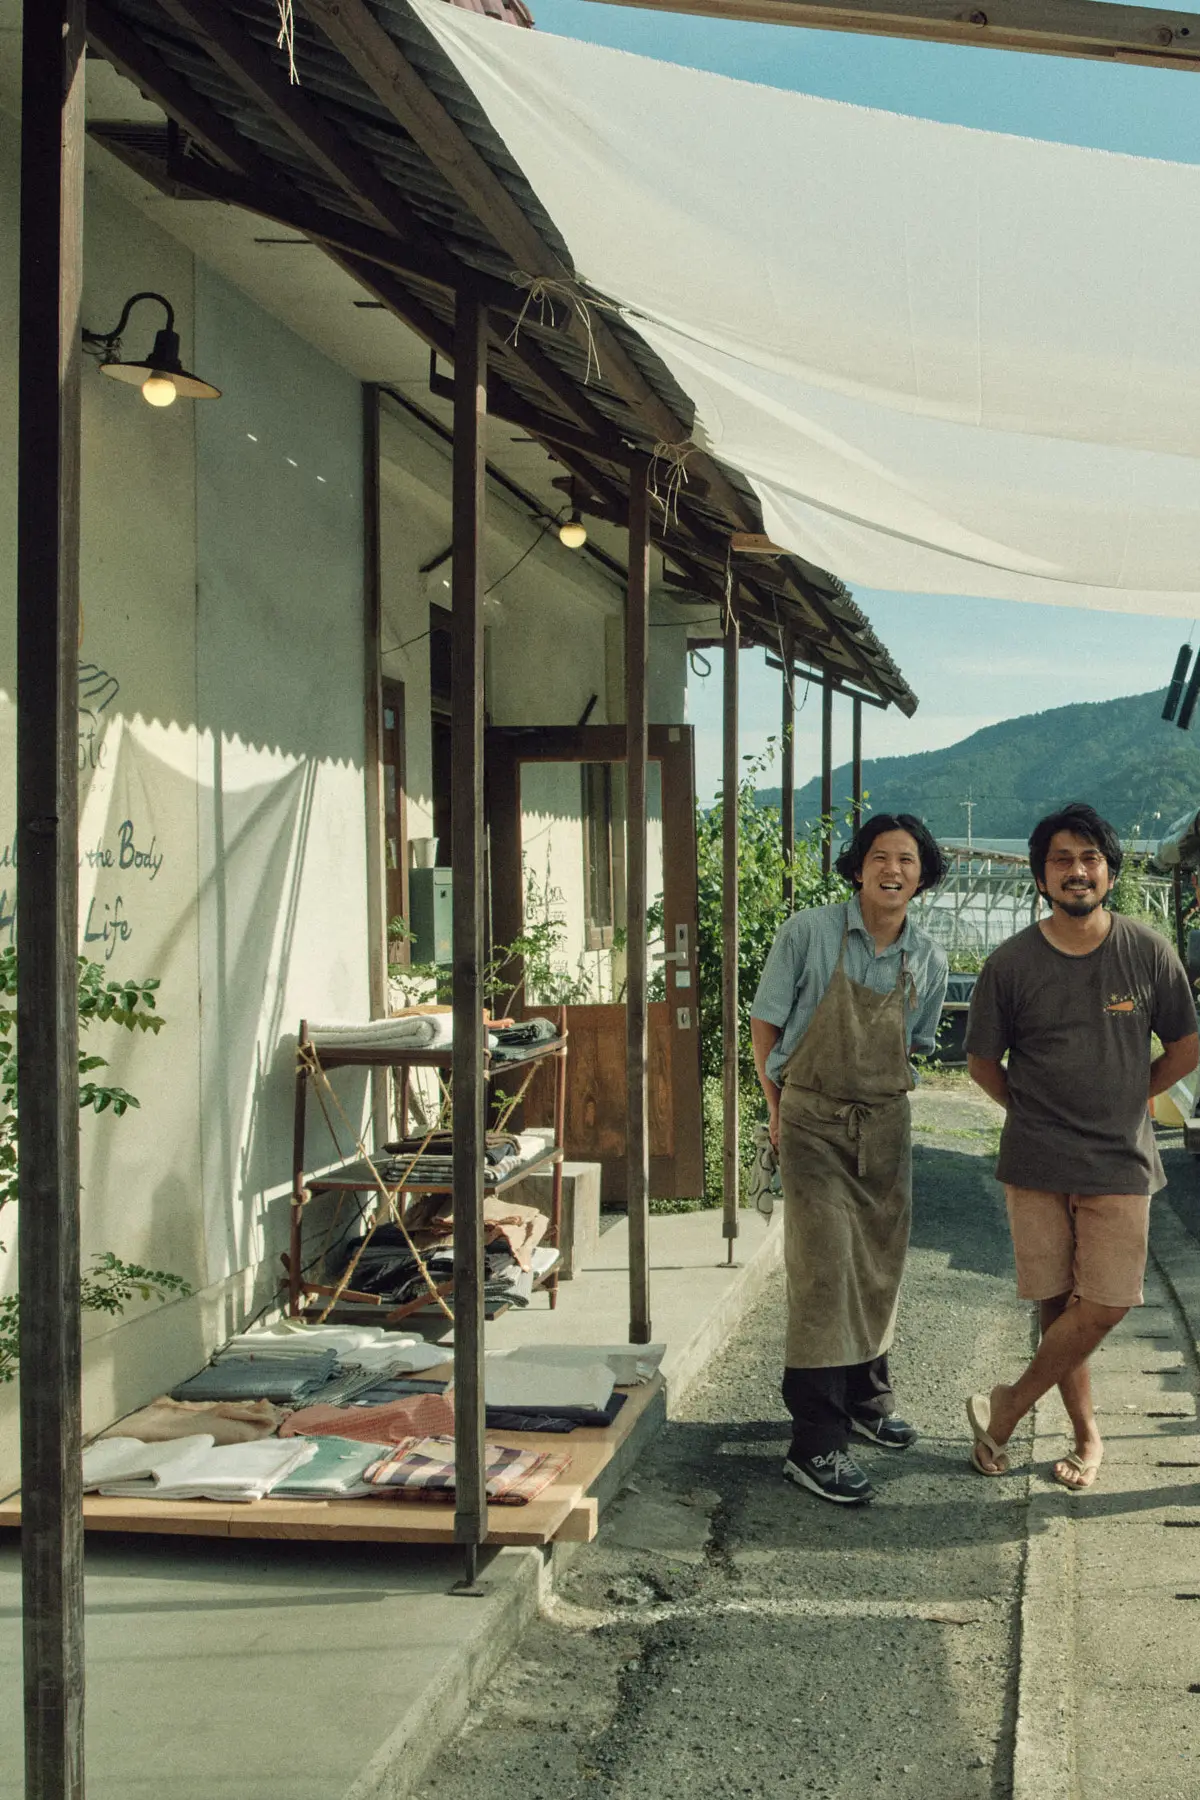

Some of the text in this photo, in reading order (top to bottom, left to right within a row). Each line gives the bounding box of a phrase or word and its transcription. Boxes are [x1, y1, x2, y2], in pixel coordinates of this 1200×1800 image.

[85, 820, 163, 881] the Body
[84, 895, 132, 961] Life
